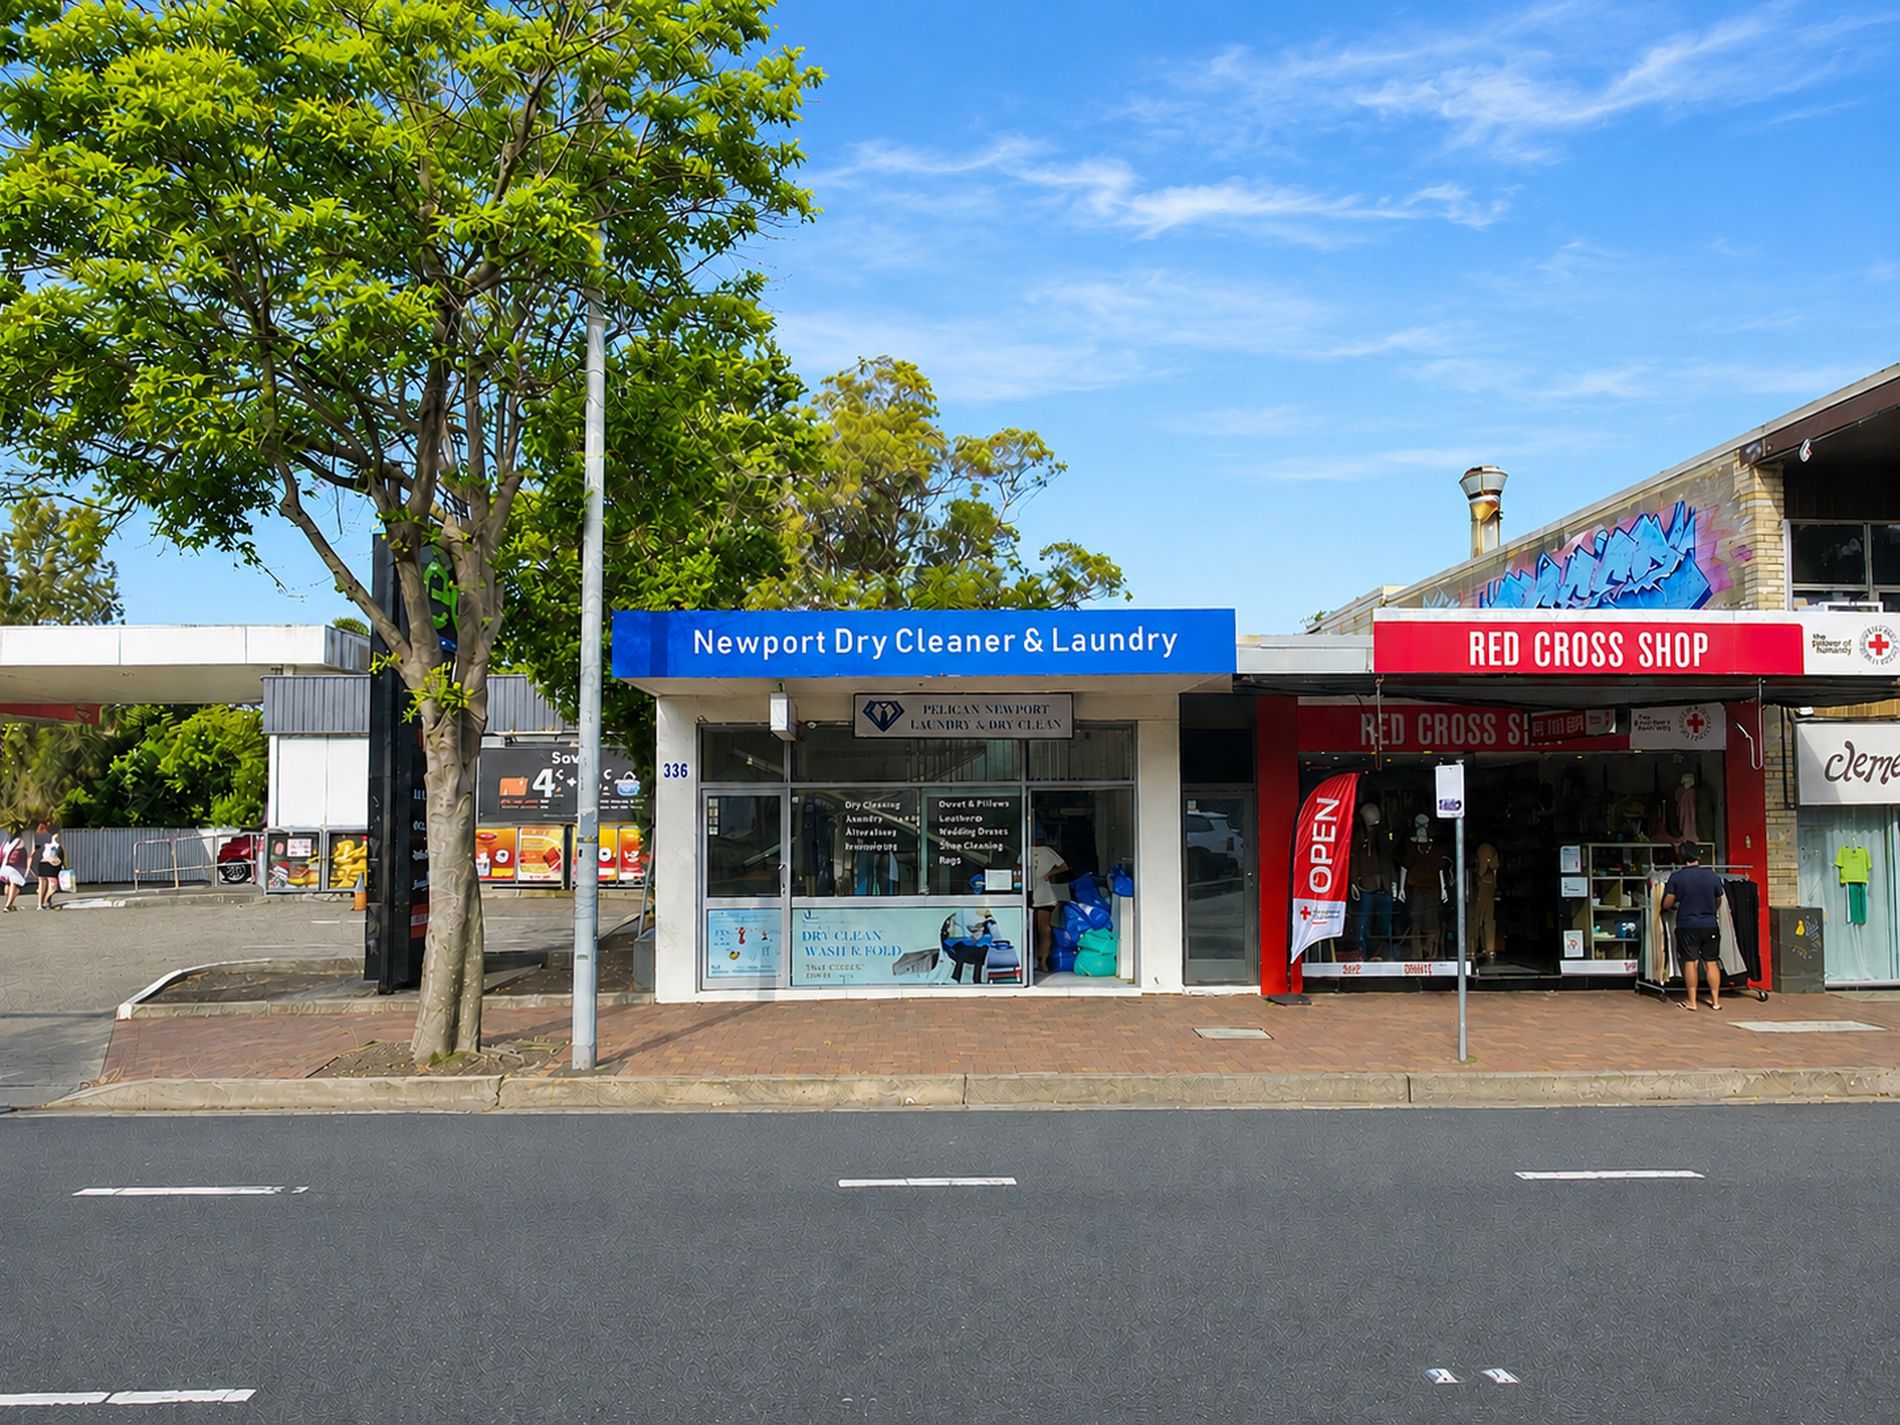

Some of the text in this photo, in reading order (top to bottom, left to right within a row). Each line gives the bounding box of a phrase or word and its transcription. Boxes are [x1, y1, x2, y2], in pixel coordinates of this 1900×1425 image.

[694, 625, 1178, 660] Newport Dry Cleaner & Laundry
[1469, 631, 1709, 668] RED CROSS SHOP
[923, 704, 1050, 715] PELICAN NEWPORT
[910, 719, 970, 730] LAUNDRY
[989, 719, 1013, 730] DRY
[1018, 719, 1062, 730] CLEAN
[1361, 713, 1404, 746] RED
[1418, 713, 1497, 745] CROSS
[663, 763, 688, 778] 336
[1309, 797, 1340, 894] OPEN
[805, 946, 846, 957] WASH
[865, 946, 902, 957] FOLD
